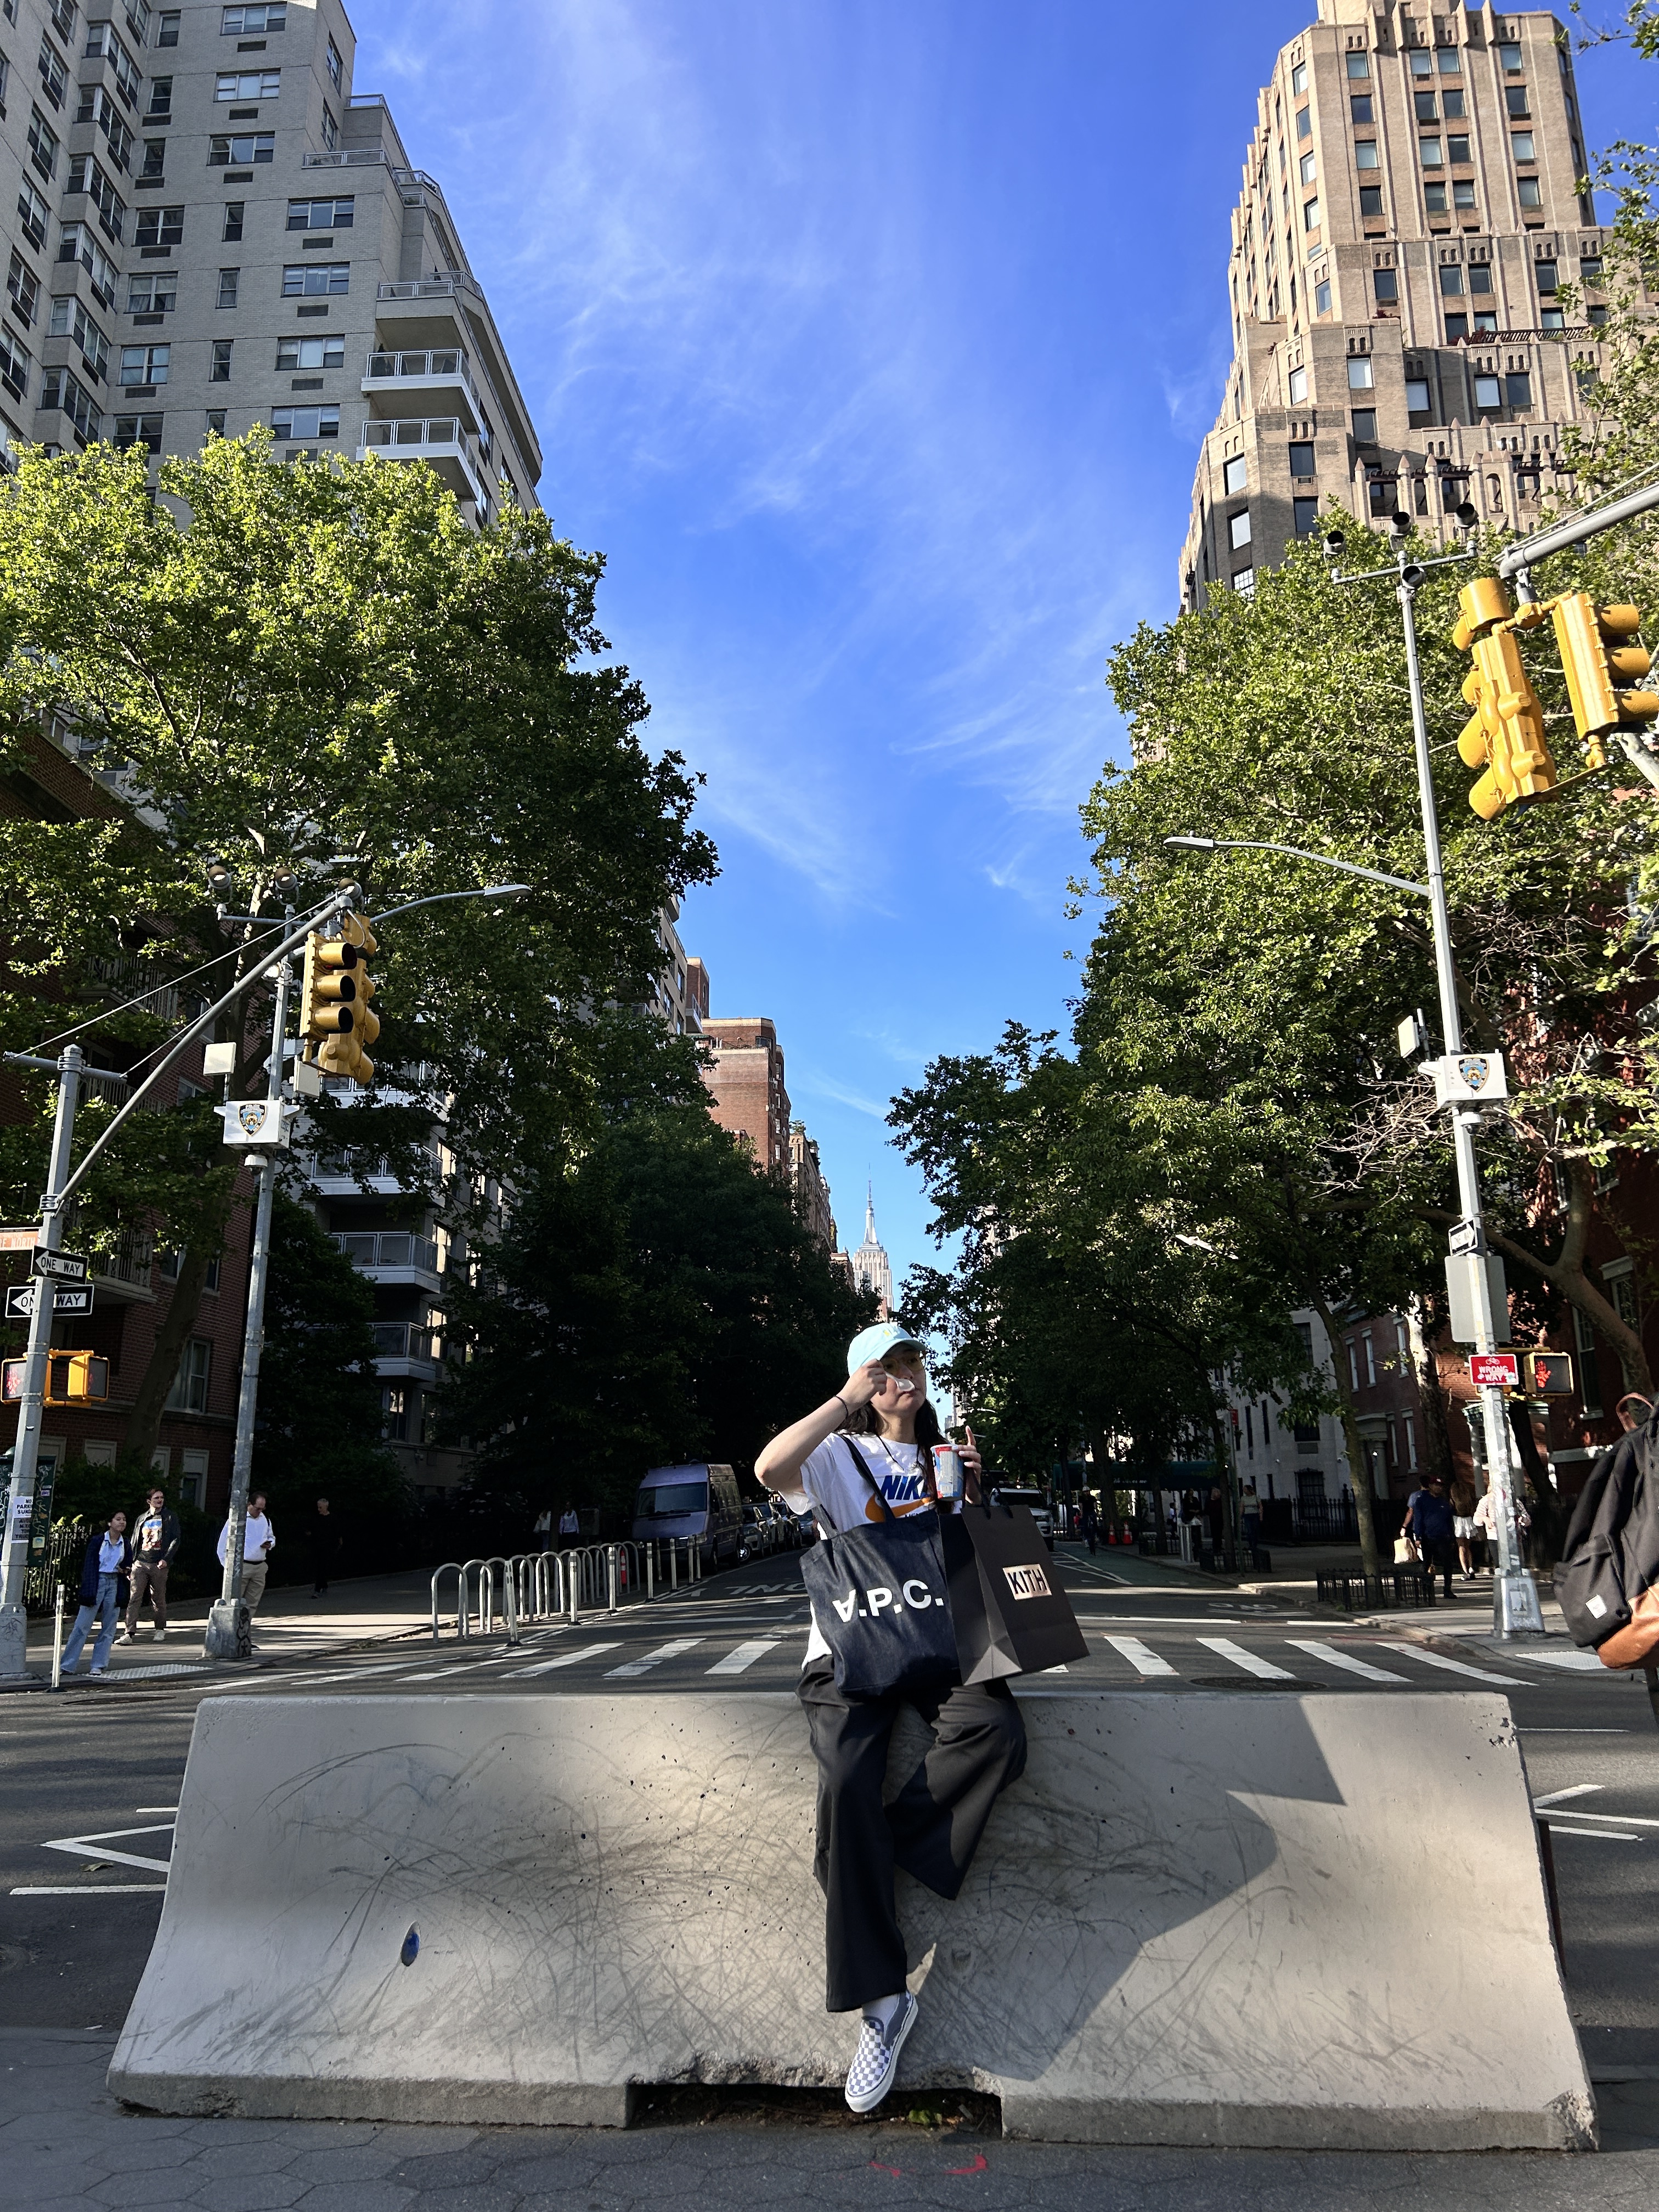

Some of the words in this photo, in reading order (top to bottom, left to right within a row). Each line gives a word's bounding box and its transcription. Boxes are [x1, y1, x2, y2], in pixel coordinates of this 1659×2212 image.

[11, 1237, 36, 1248] NORTH
[41, 1257, 56, 1269] ONE
[64, 1261, 80, 1275] WAY
[21, 1296, 34, 1307] ON
[57, 1295, 82, 1306] WAY
[1478, 1365, 1509, 1373] WRONG
[1485, 1373, 1504, 1381] WAY
[1008, 1570, 1047, 1594] KITH
